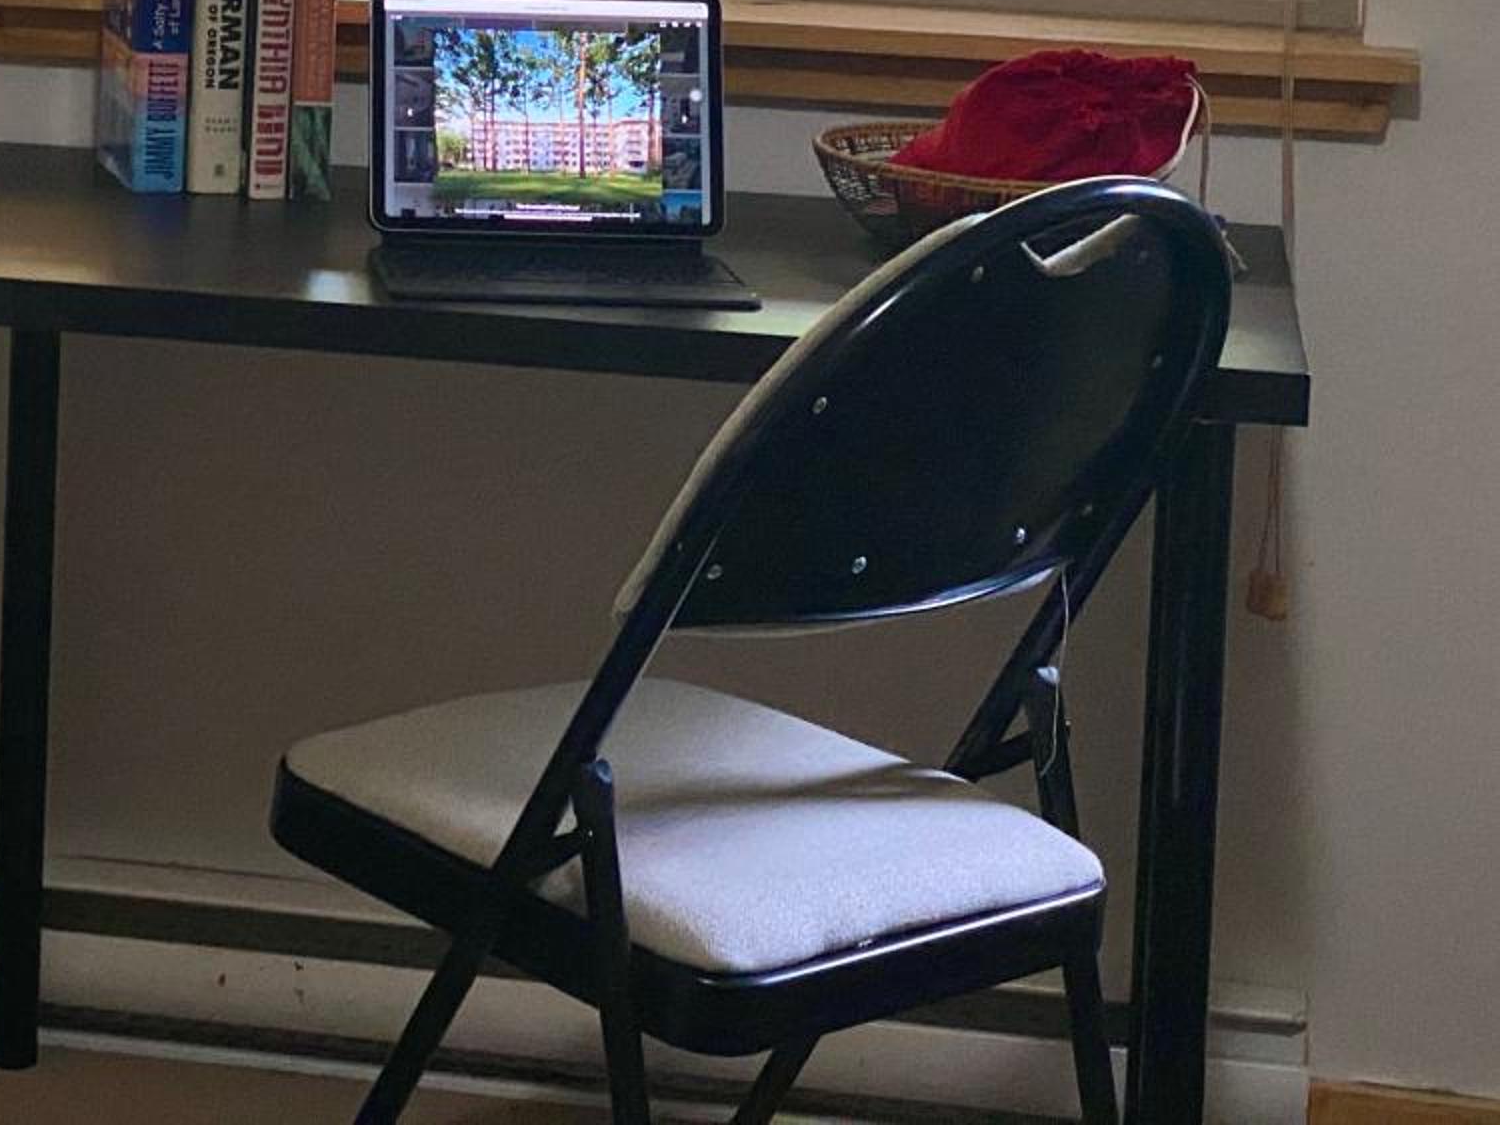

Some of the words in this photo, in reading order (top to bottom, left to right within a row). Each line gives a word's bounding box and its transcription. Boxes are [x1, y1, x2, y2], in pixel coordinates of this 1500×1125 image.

[208, 6, 218, 22] OF
[205, 29, 218, 89] OREGON
[145, 127, 176, 179] JIMMY
